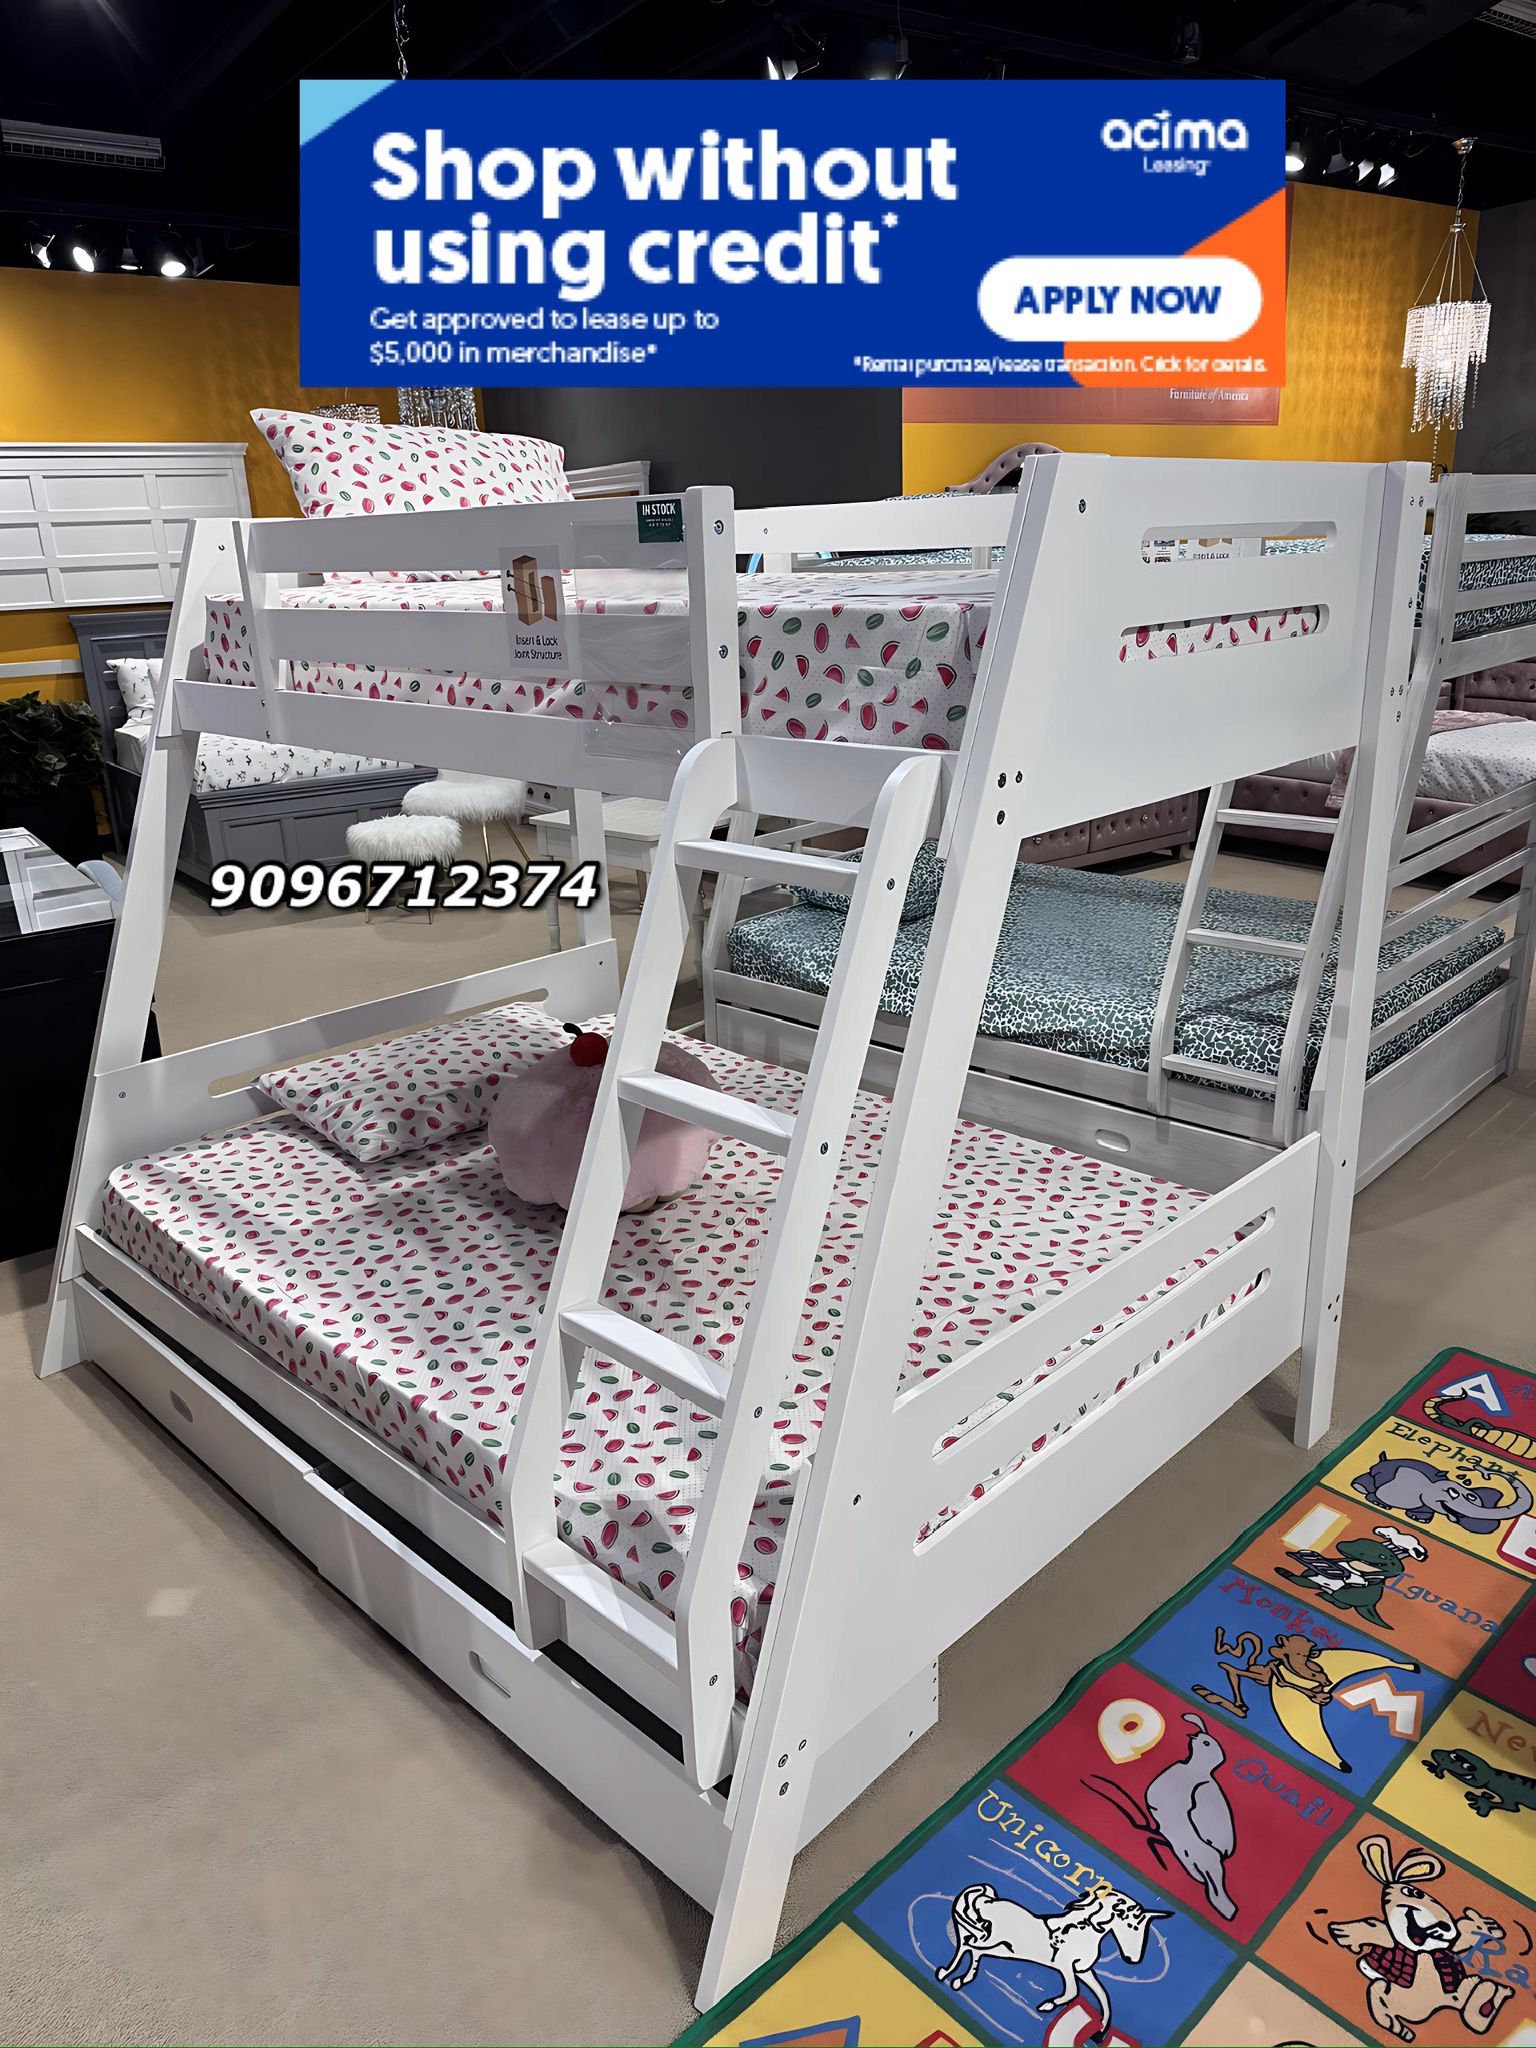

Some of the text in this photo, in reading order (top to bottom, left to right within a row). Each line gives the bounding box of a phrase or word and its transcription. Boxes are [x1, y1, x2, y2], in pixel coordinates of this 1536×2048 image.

[651, 503, 676, 515] STOCK
[1384, 1421, 1522, 1484] Elephant
[1219, 1574, 1343, 1648] Monkey
[1382, 1570, 1499, 1633] Iguana
[1233, 1755, 1335, 1828] Quail
[976, 1788, 1113, 1901] Unicorn
[1455, 1930, 1536, 1999] Ra
